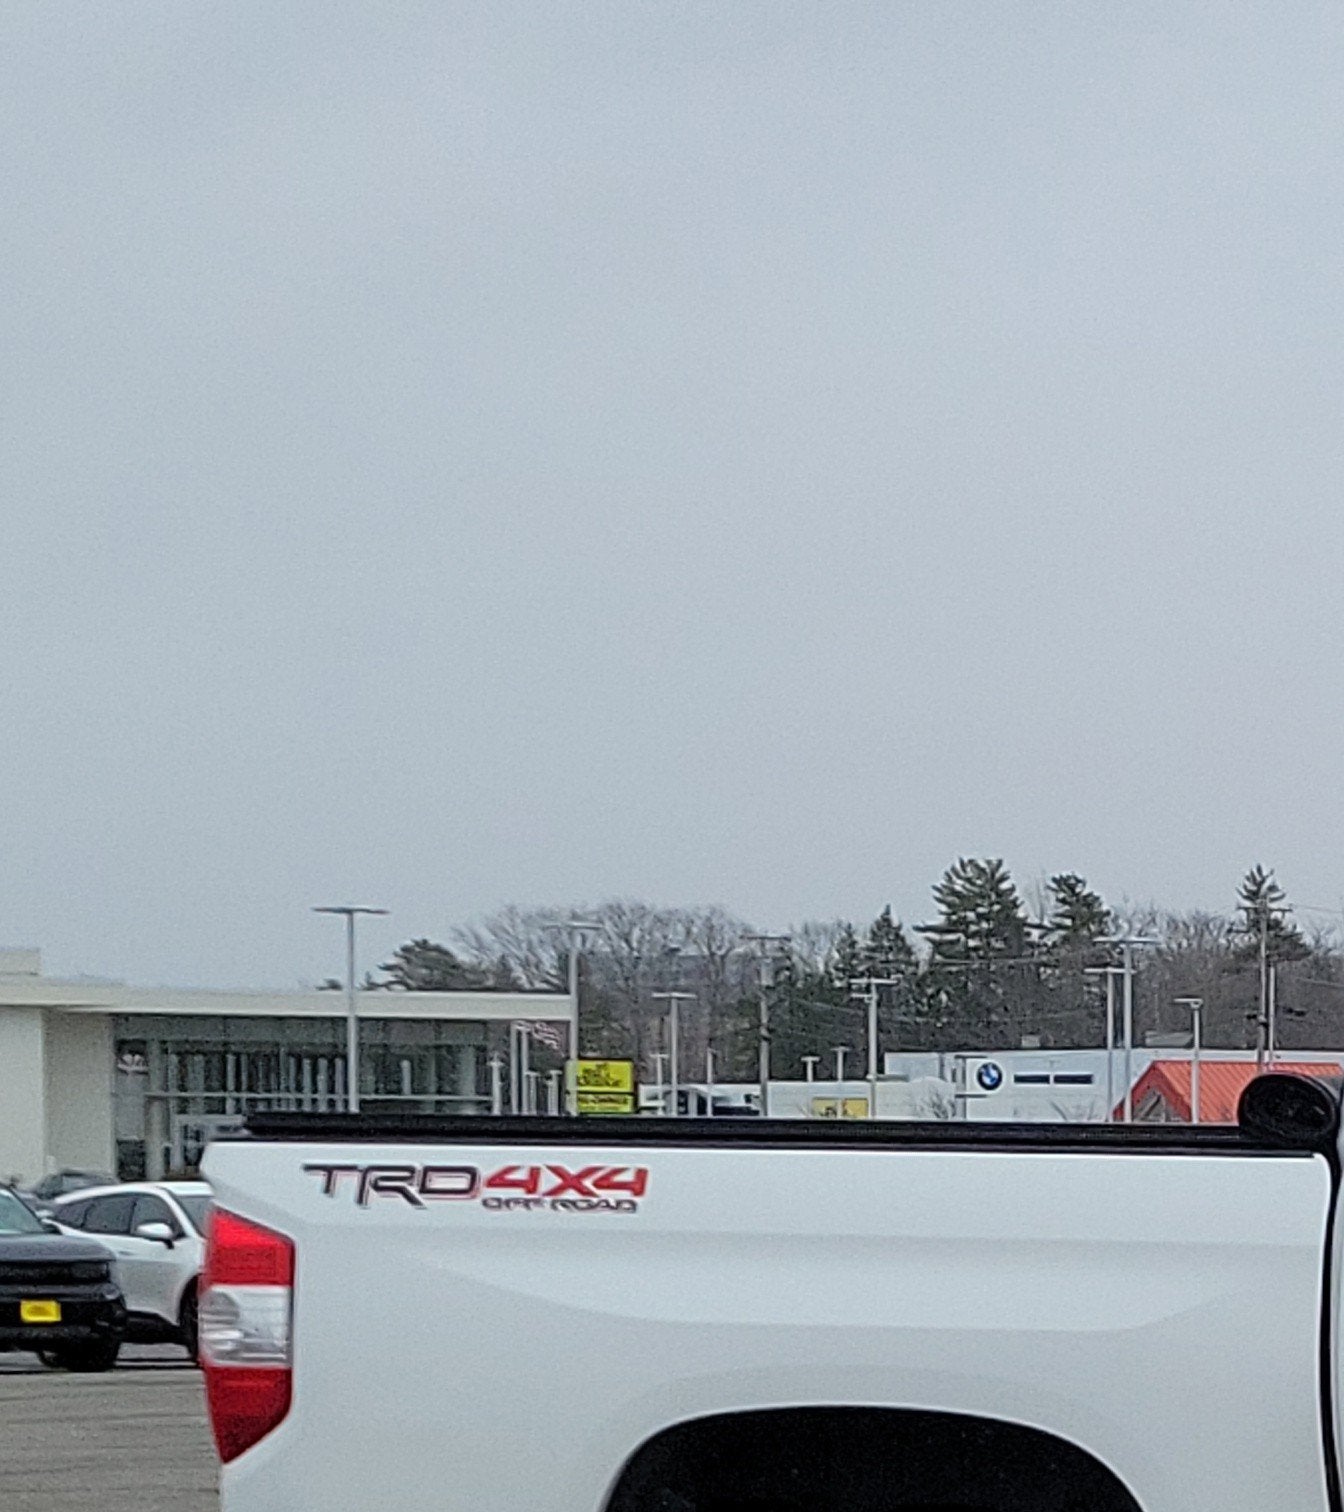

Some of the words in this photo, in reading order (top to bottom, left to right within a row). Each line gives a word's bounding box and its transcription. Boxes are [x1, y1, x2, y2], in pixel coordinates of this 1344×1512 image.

[302, 1163, 481, 1209] TRD
[484, 1164, 649, 1198] 4X4
[481, 1197, 547, 1213] OFF
[549, 1198, 638, 1214] ROAD
